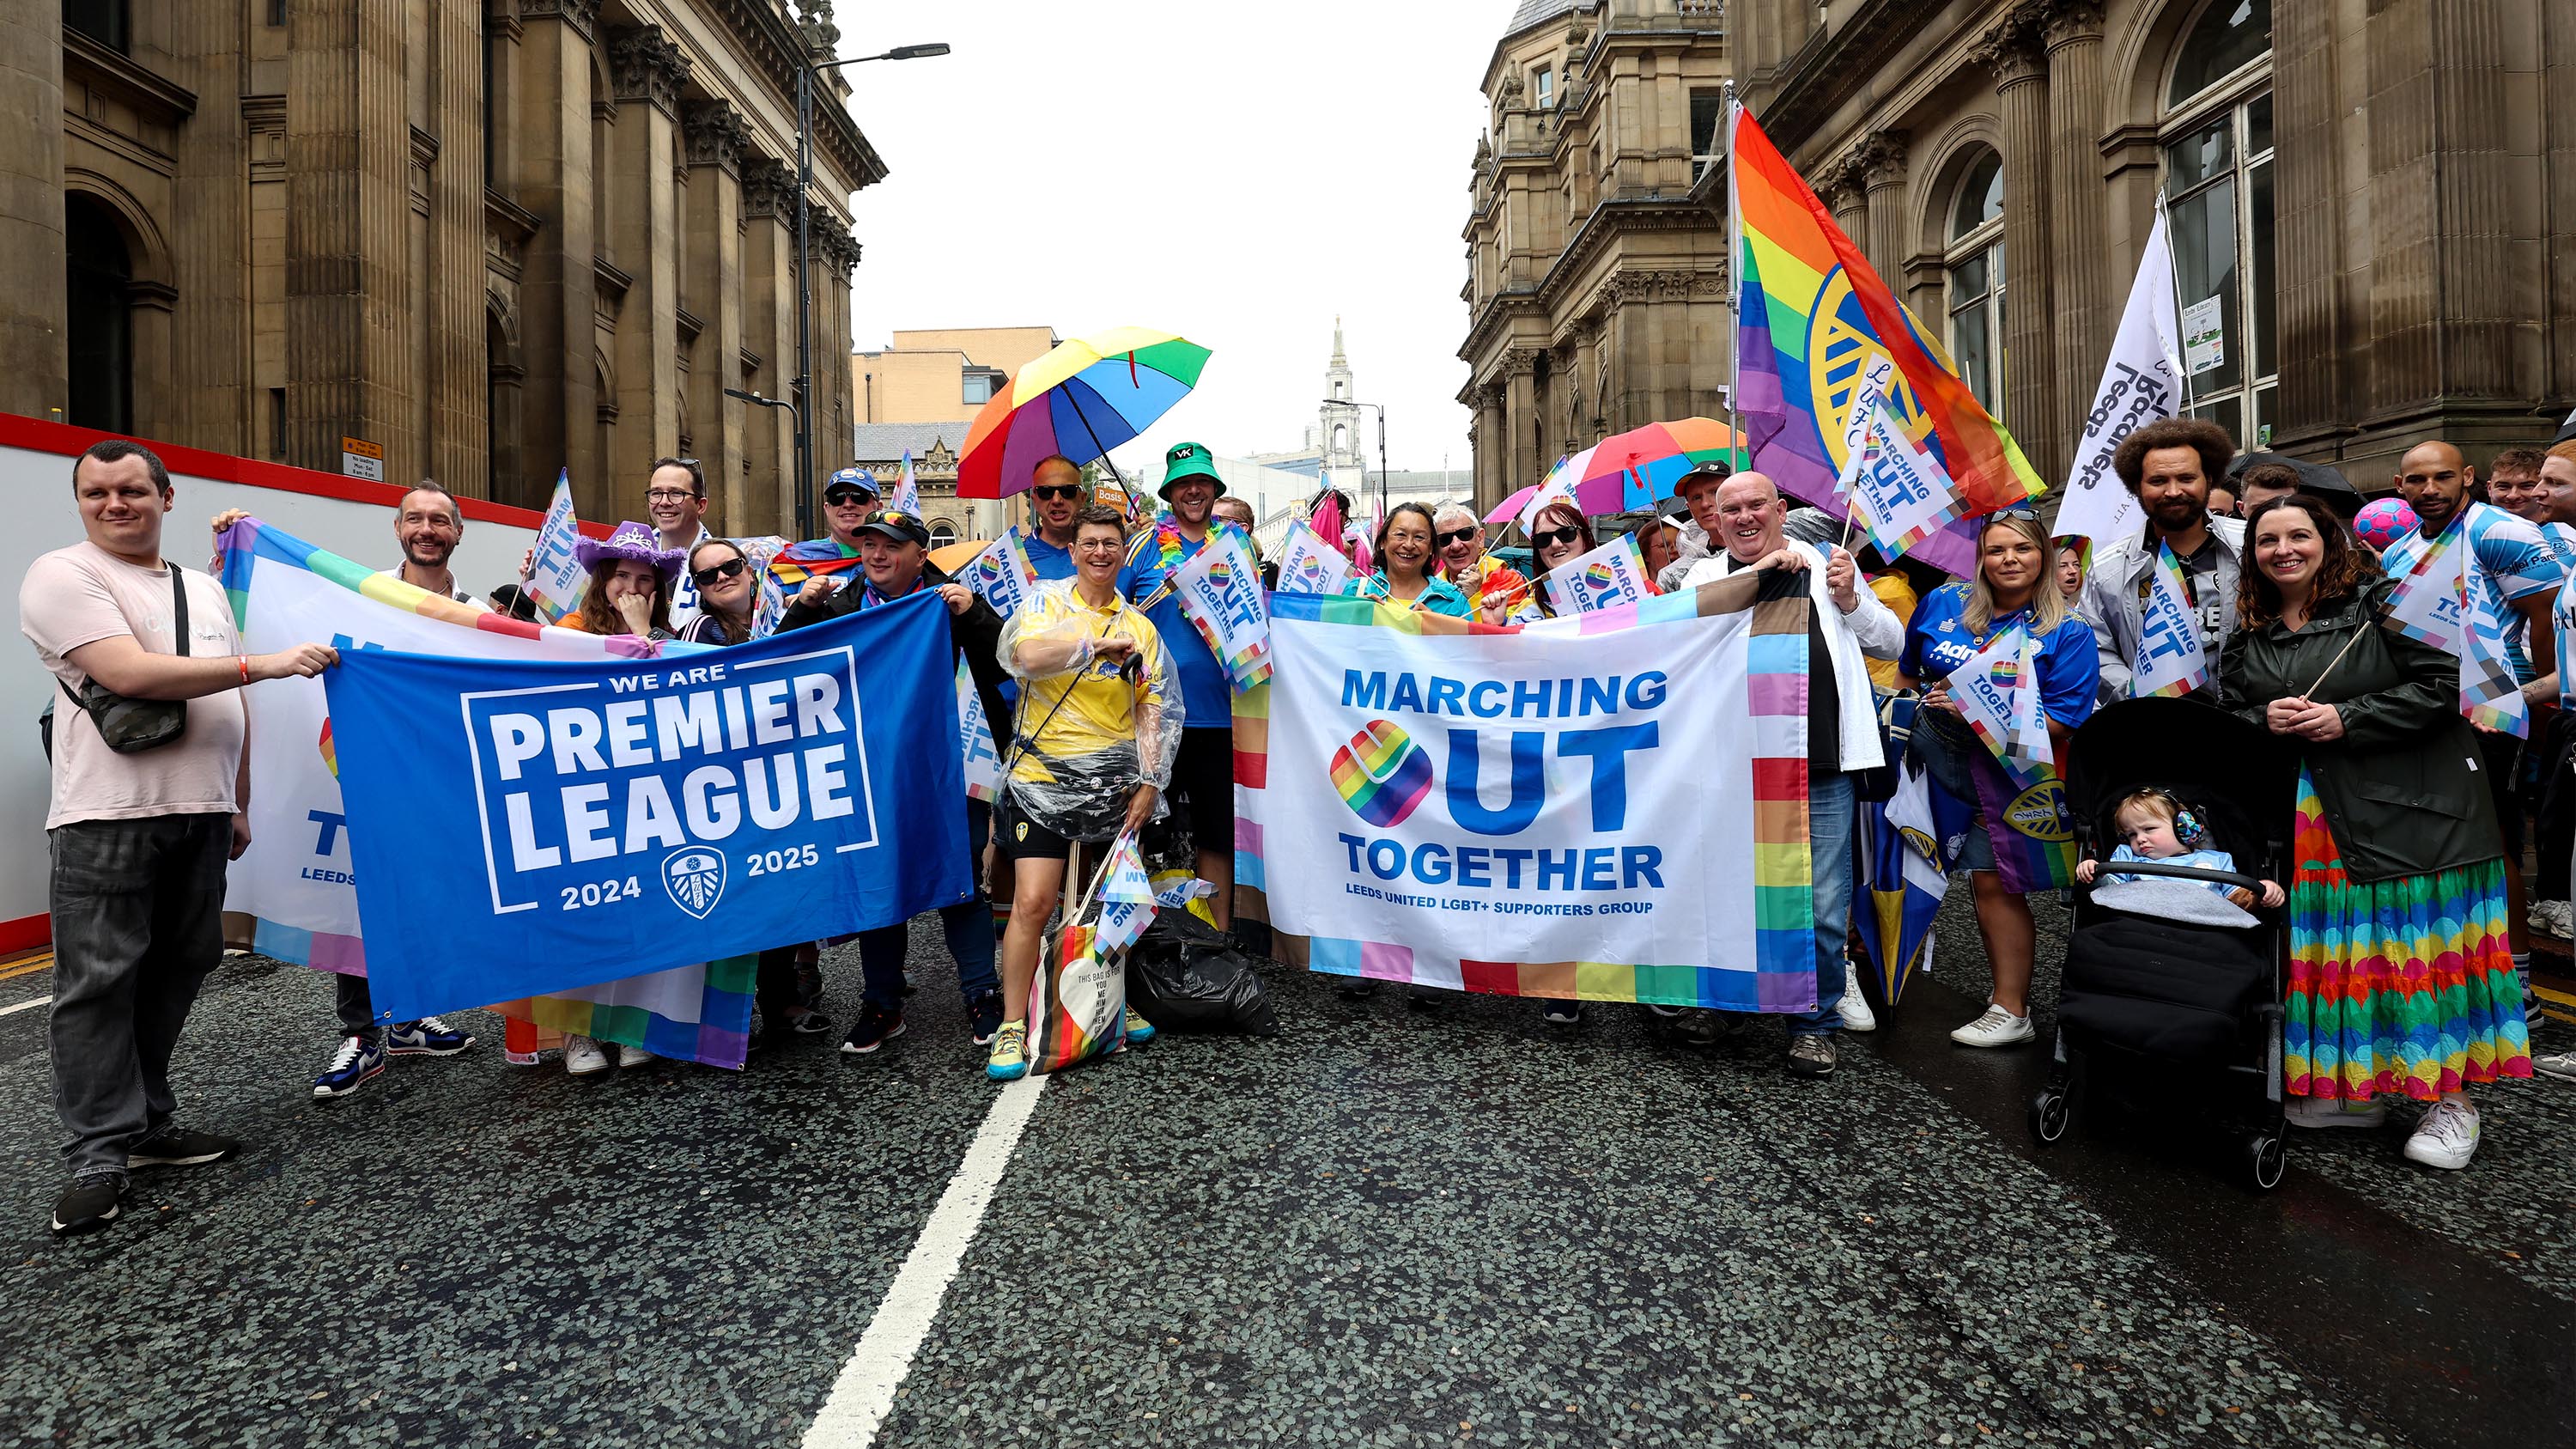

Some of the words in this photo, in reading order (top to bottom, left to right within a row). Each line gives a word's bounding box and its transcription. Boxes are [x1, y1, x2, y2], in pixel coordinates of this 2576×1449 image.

[1176, 448, 1192, 458] VK
[1873, 422, 1930, 499] MARCHING
[1099, 490, 1122, 502] Basis
[1859, 469, 1893, 524] ETHER
[998, 547, 1023, 609] MARCHI
[2494, 560, 2530, 576] arallel
[1226, 551, 1262, 622] MARCHING
[1571, 572, 1595, 612] TOGE
[1195, 575, 1235, 643] TOGETHER
[2151, 569, 2196, 654] MARCHING
[608, 674, 659, 693] WE
[669, 664, 726, 687] ARE
[1341, 668, 1668, 718] MARCHING
[1974, 673, 2012, 727] TOGET
[489, 673, 847, 781] PREMIER
[504, 743, 854, 873] LEAGUE
[301, 867, 355, 886] LEEDS
[747, 844, 819, 877] 2025
[1338, 832, 1666, 891] TOGETHER
[561, 875, 641, 911] 2024
[1346, 883, 1382, 899] LEEDS
[1385, 892, 1436, 908] UNITED
[1442, 899, 1489, 912] LGBT+
[1494, 902, 1594, 916] SUPPORTERS
[1599, 902, 1653, 916] GROUP
[1078, 974, 1091, 983] THIS
[1093, 972, 1104, 981] BAG
[1105, 969, 1110, 978] IS
[1112, 967, 1121, 977] FOR
[1096, 981, 1107, 989] YOU
[1096, 999, 1106, 1008] HIM
[1097, 989, 1105, 998] ME
[1092, 1015, 1106, 1026] THEM
[1096, 1008, 1105, 1017] HER
